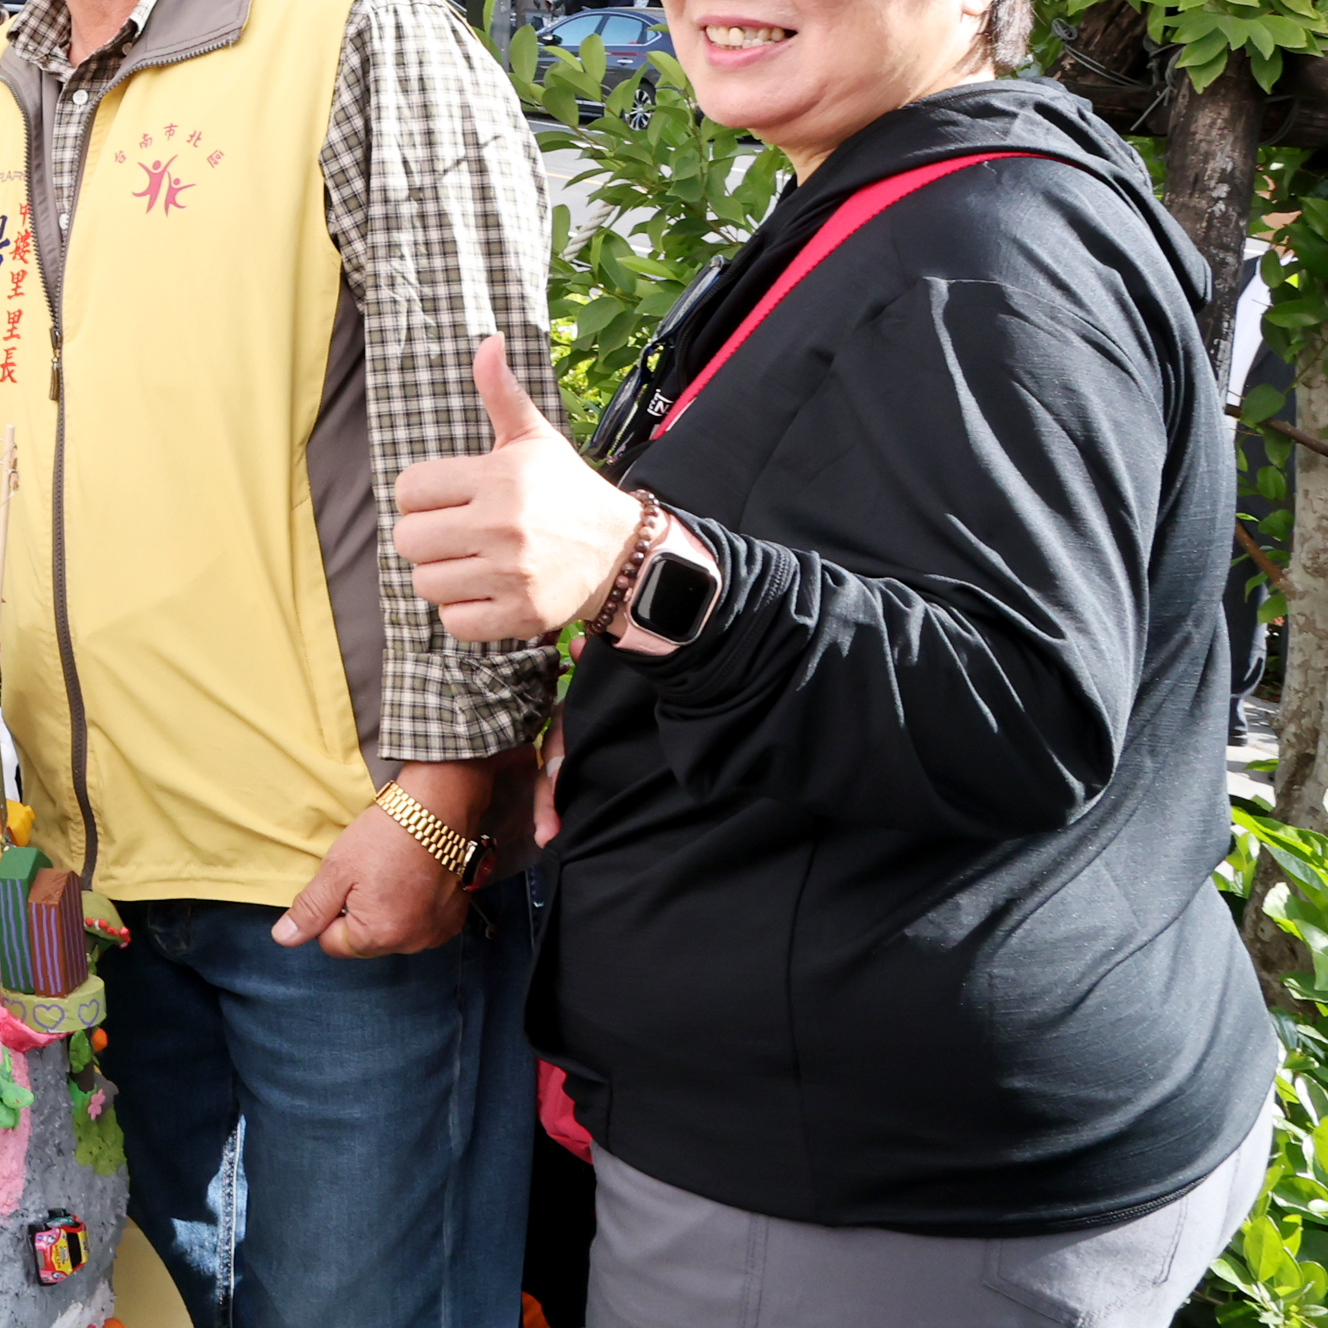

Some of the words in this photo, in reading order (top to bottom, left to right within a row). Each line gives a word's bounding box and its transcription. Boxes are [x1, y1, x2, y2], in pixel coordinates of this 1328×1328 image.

[114, 122, 225, 169] 台南市北區
